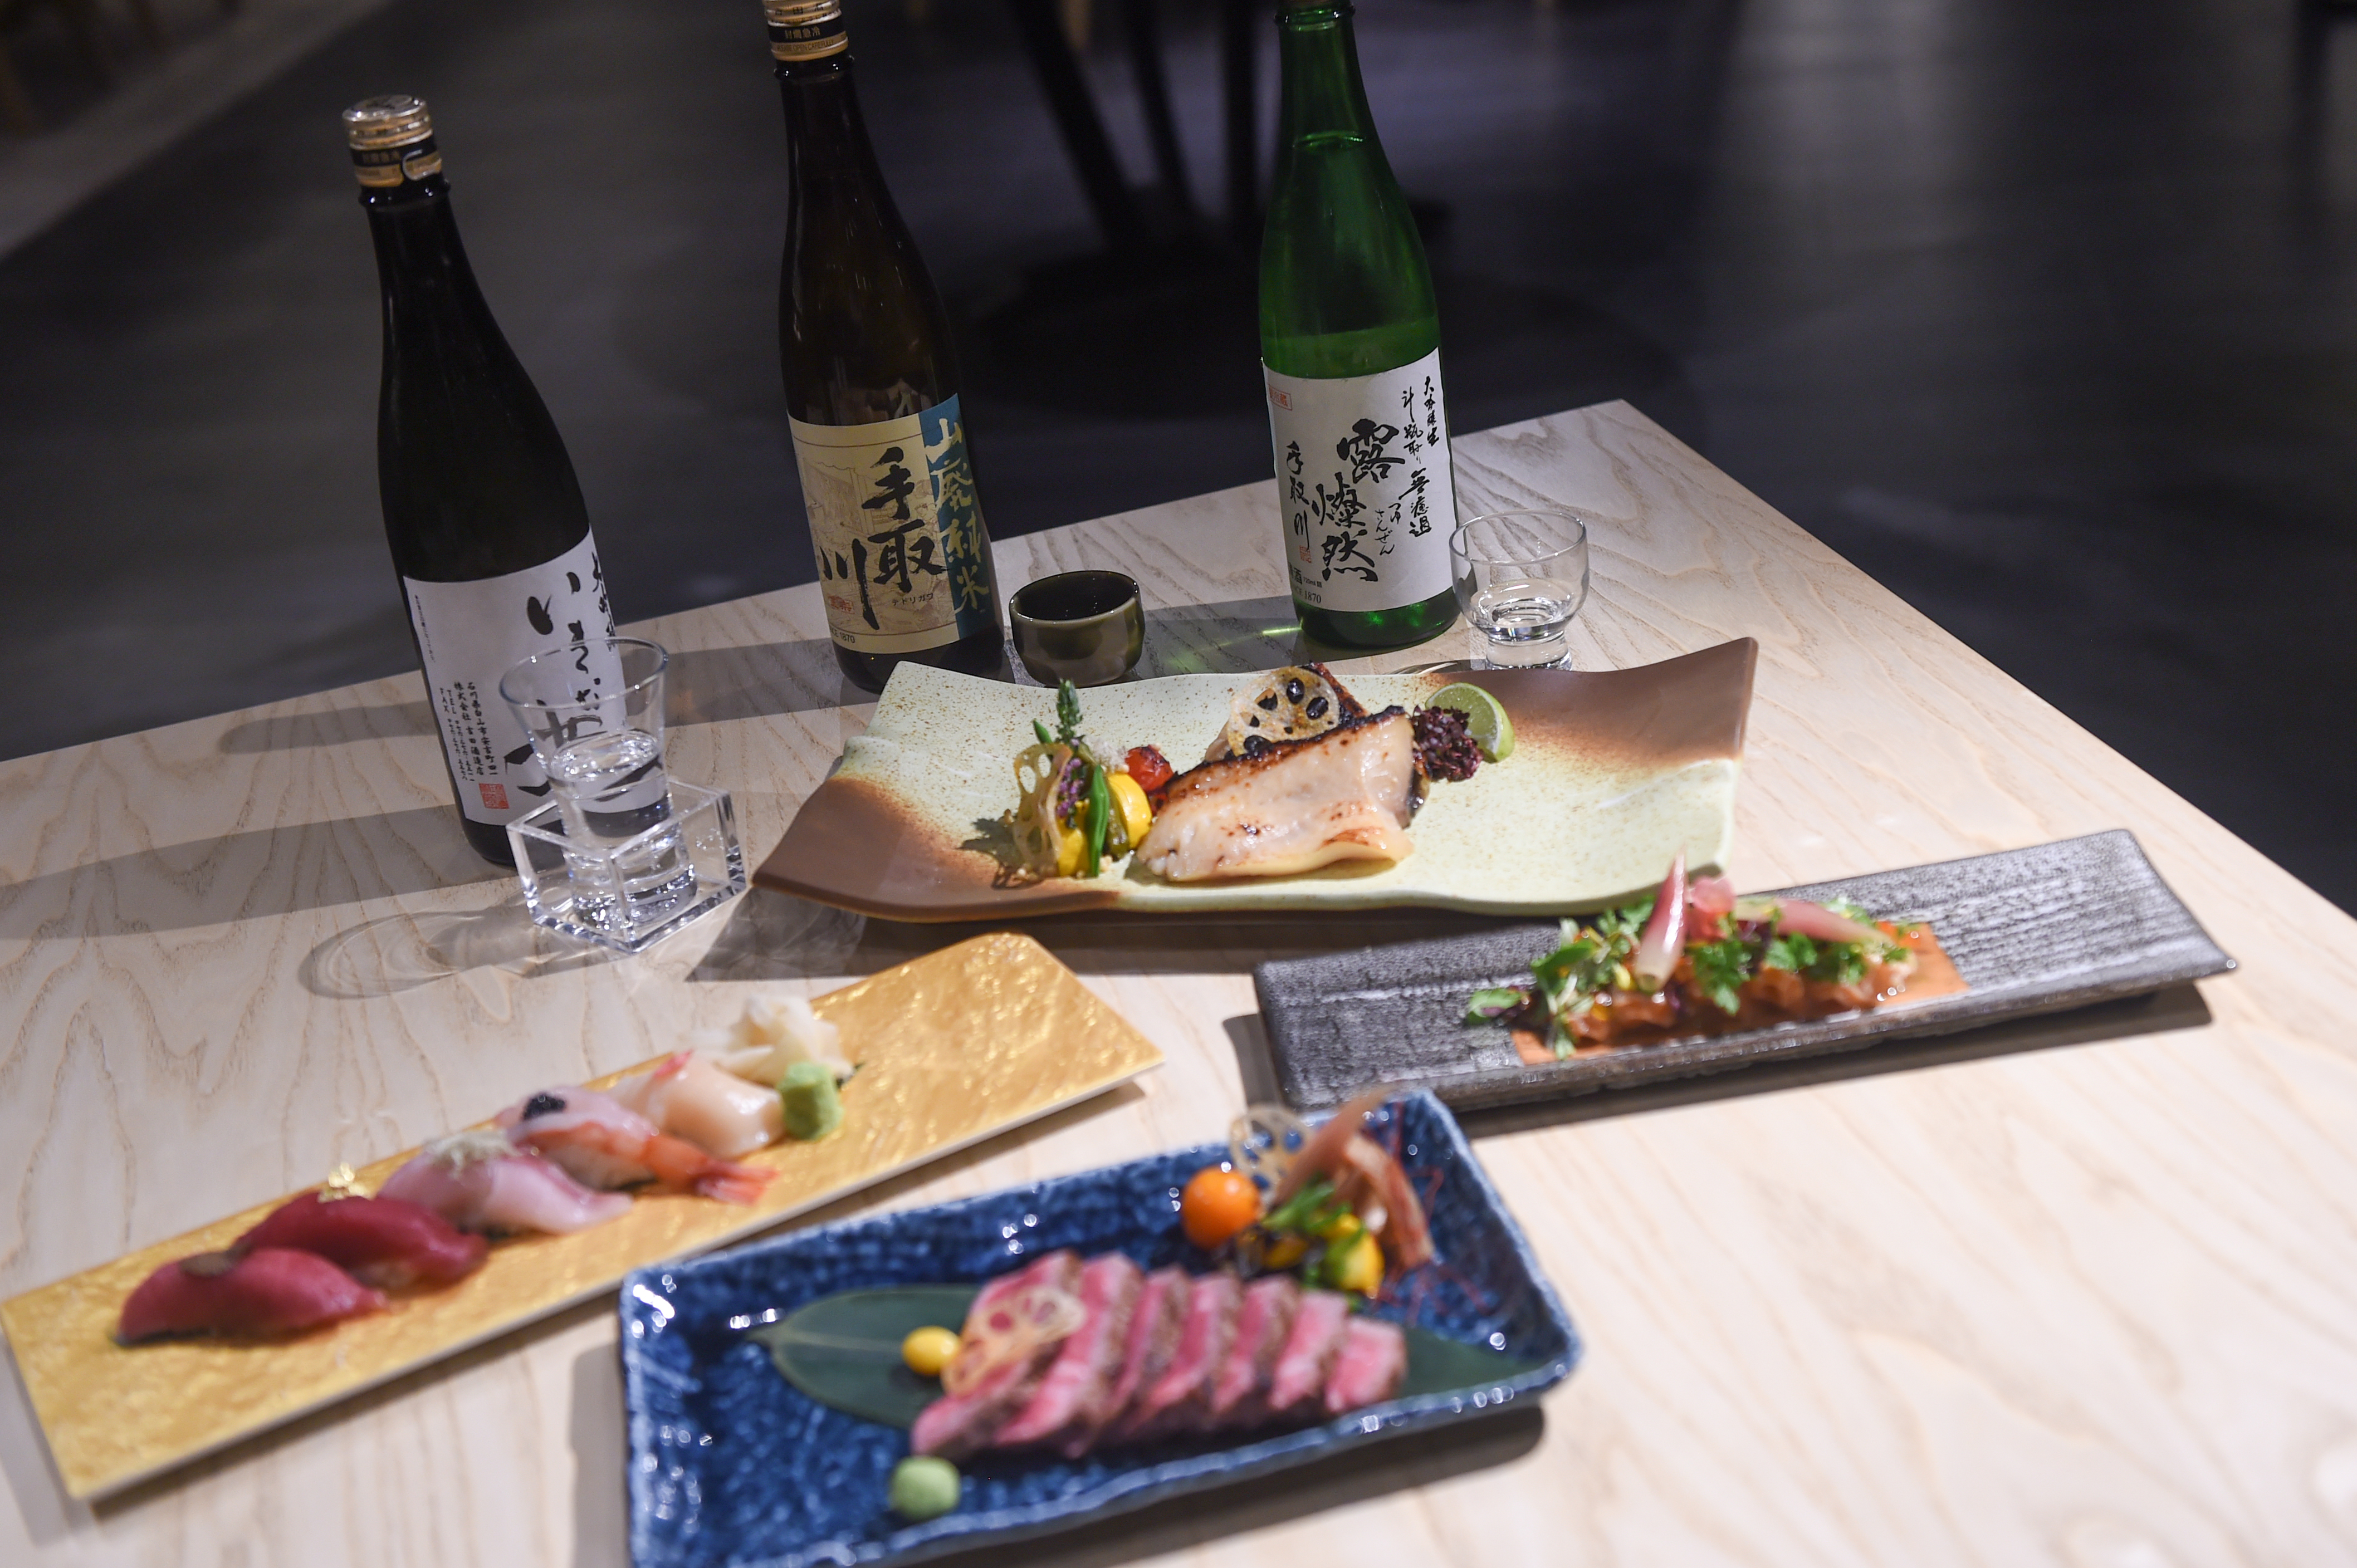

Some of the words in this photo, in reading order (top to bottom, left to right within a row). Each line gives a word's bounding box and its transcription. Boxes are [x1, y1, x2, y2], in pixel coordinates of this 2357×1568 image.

[819, 446, 949, 630] 手取川
[892, 592, 933, 606] テドリガワ
[1305, 590, 1322, 604] 1870
[839, 631, 855, 644] 1870
